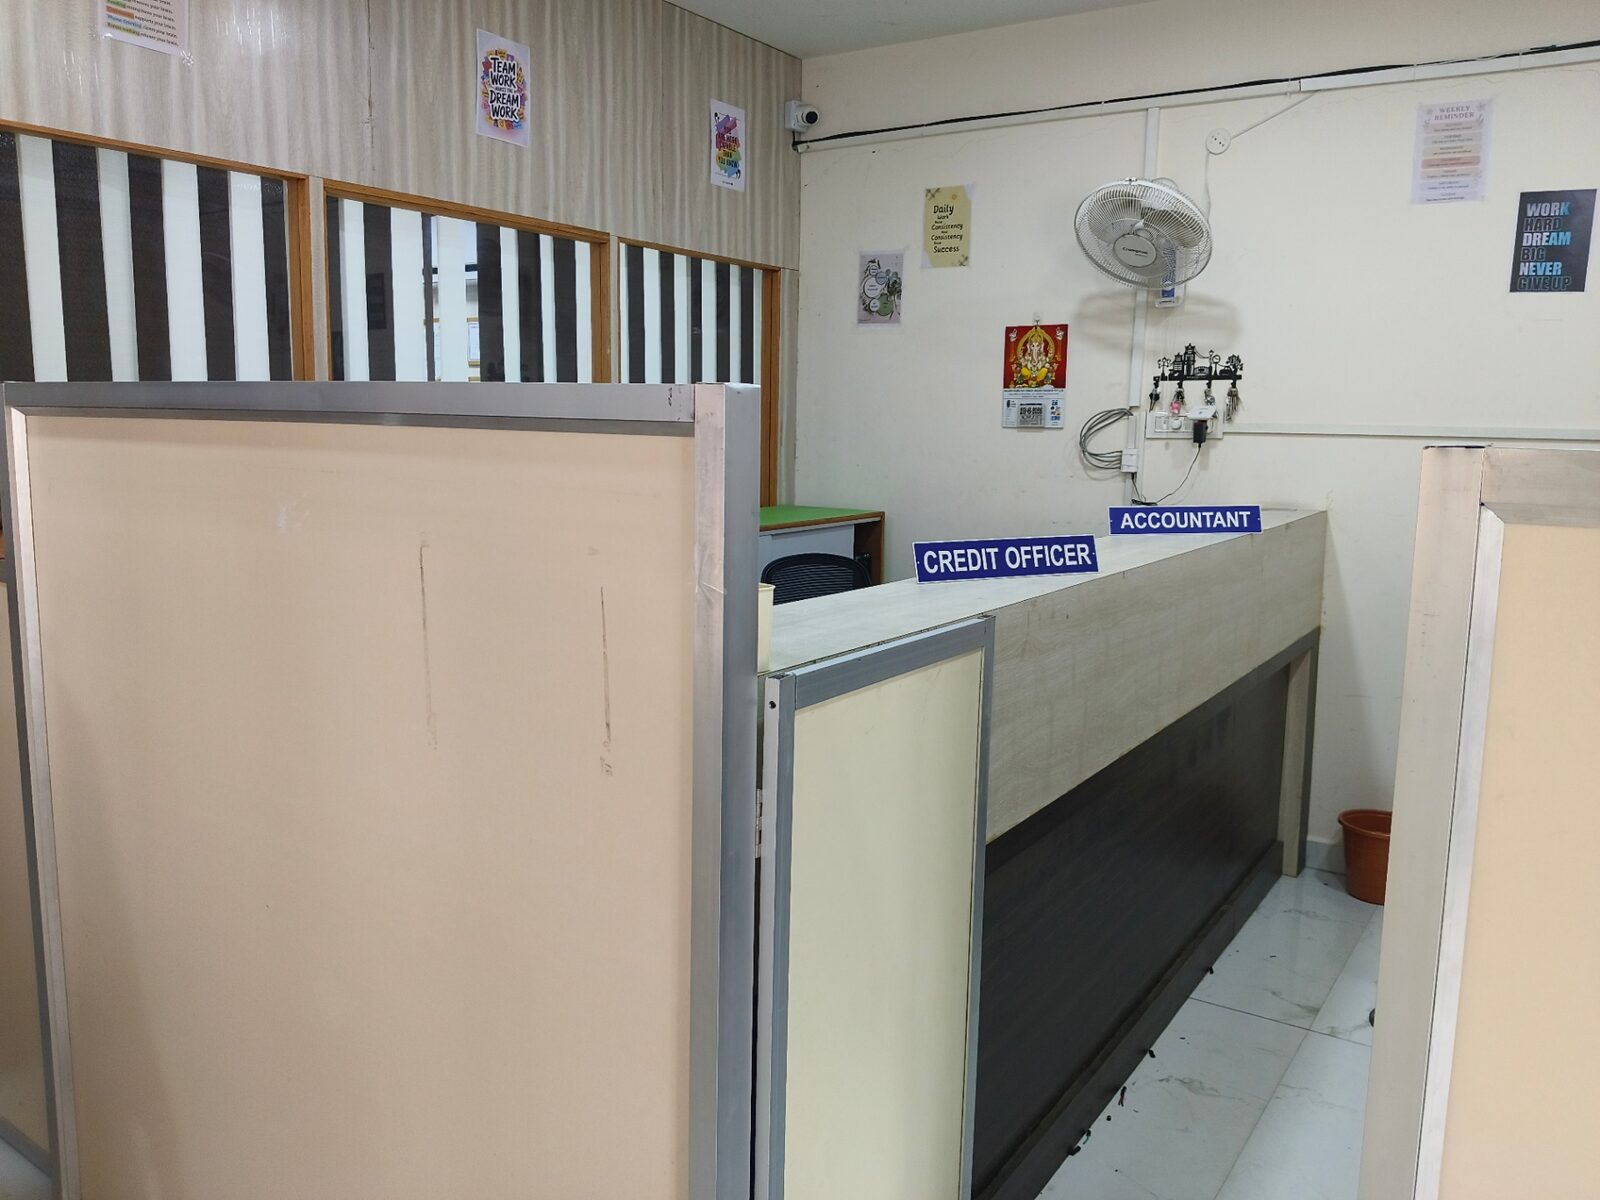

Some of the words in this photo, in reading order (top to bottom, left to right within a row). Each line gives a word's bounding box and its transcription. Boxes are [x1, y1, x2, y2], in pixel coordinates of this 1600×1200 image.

[490, 57, 516, 76] TEAM
[490, 72, 516, 88] WORK
[490, 90, 519, 107] DREAM
[491, 104, 518, 120] WORK
[1434, 111, 1475, 121] REMINDER
[1439, 105, 1471, 114] WEEKLY
[933, 204, 954, 216] Daily
[1526, 202, 1570, 217] WORK
[931, 223, 964, 231] Consistency
[1523, 217, 1561, 232] HARD
[1522, 231, 1572, 246] DREAM
[933, 245, 960, 253] Success
[1520, 247, 1546, 262] BIG
[1519, 261, 1563, 276] NEVER
[1120, 510, 1251, 530] ACCOUNTANT
[923, 547, 999, 575] CREDIT
[1004, 543, 1092, 570] OFFICER
